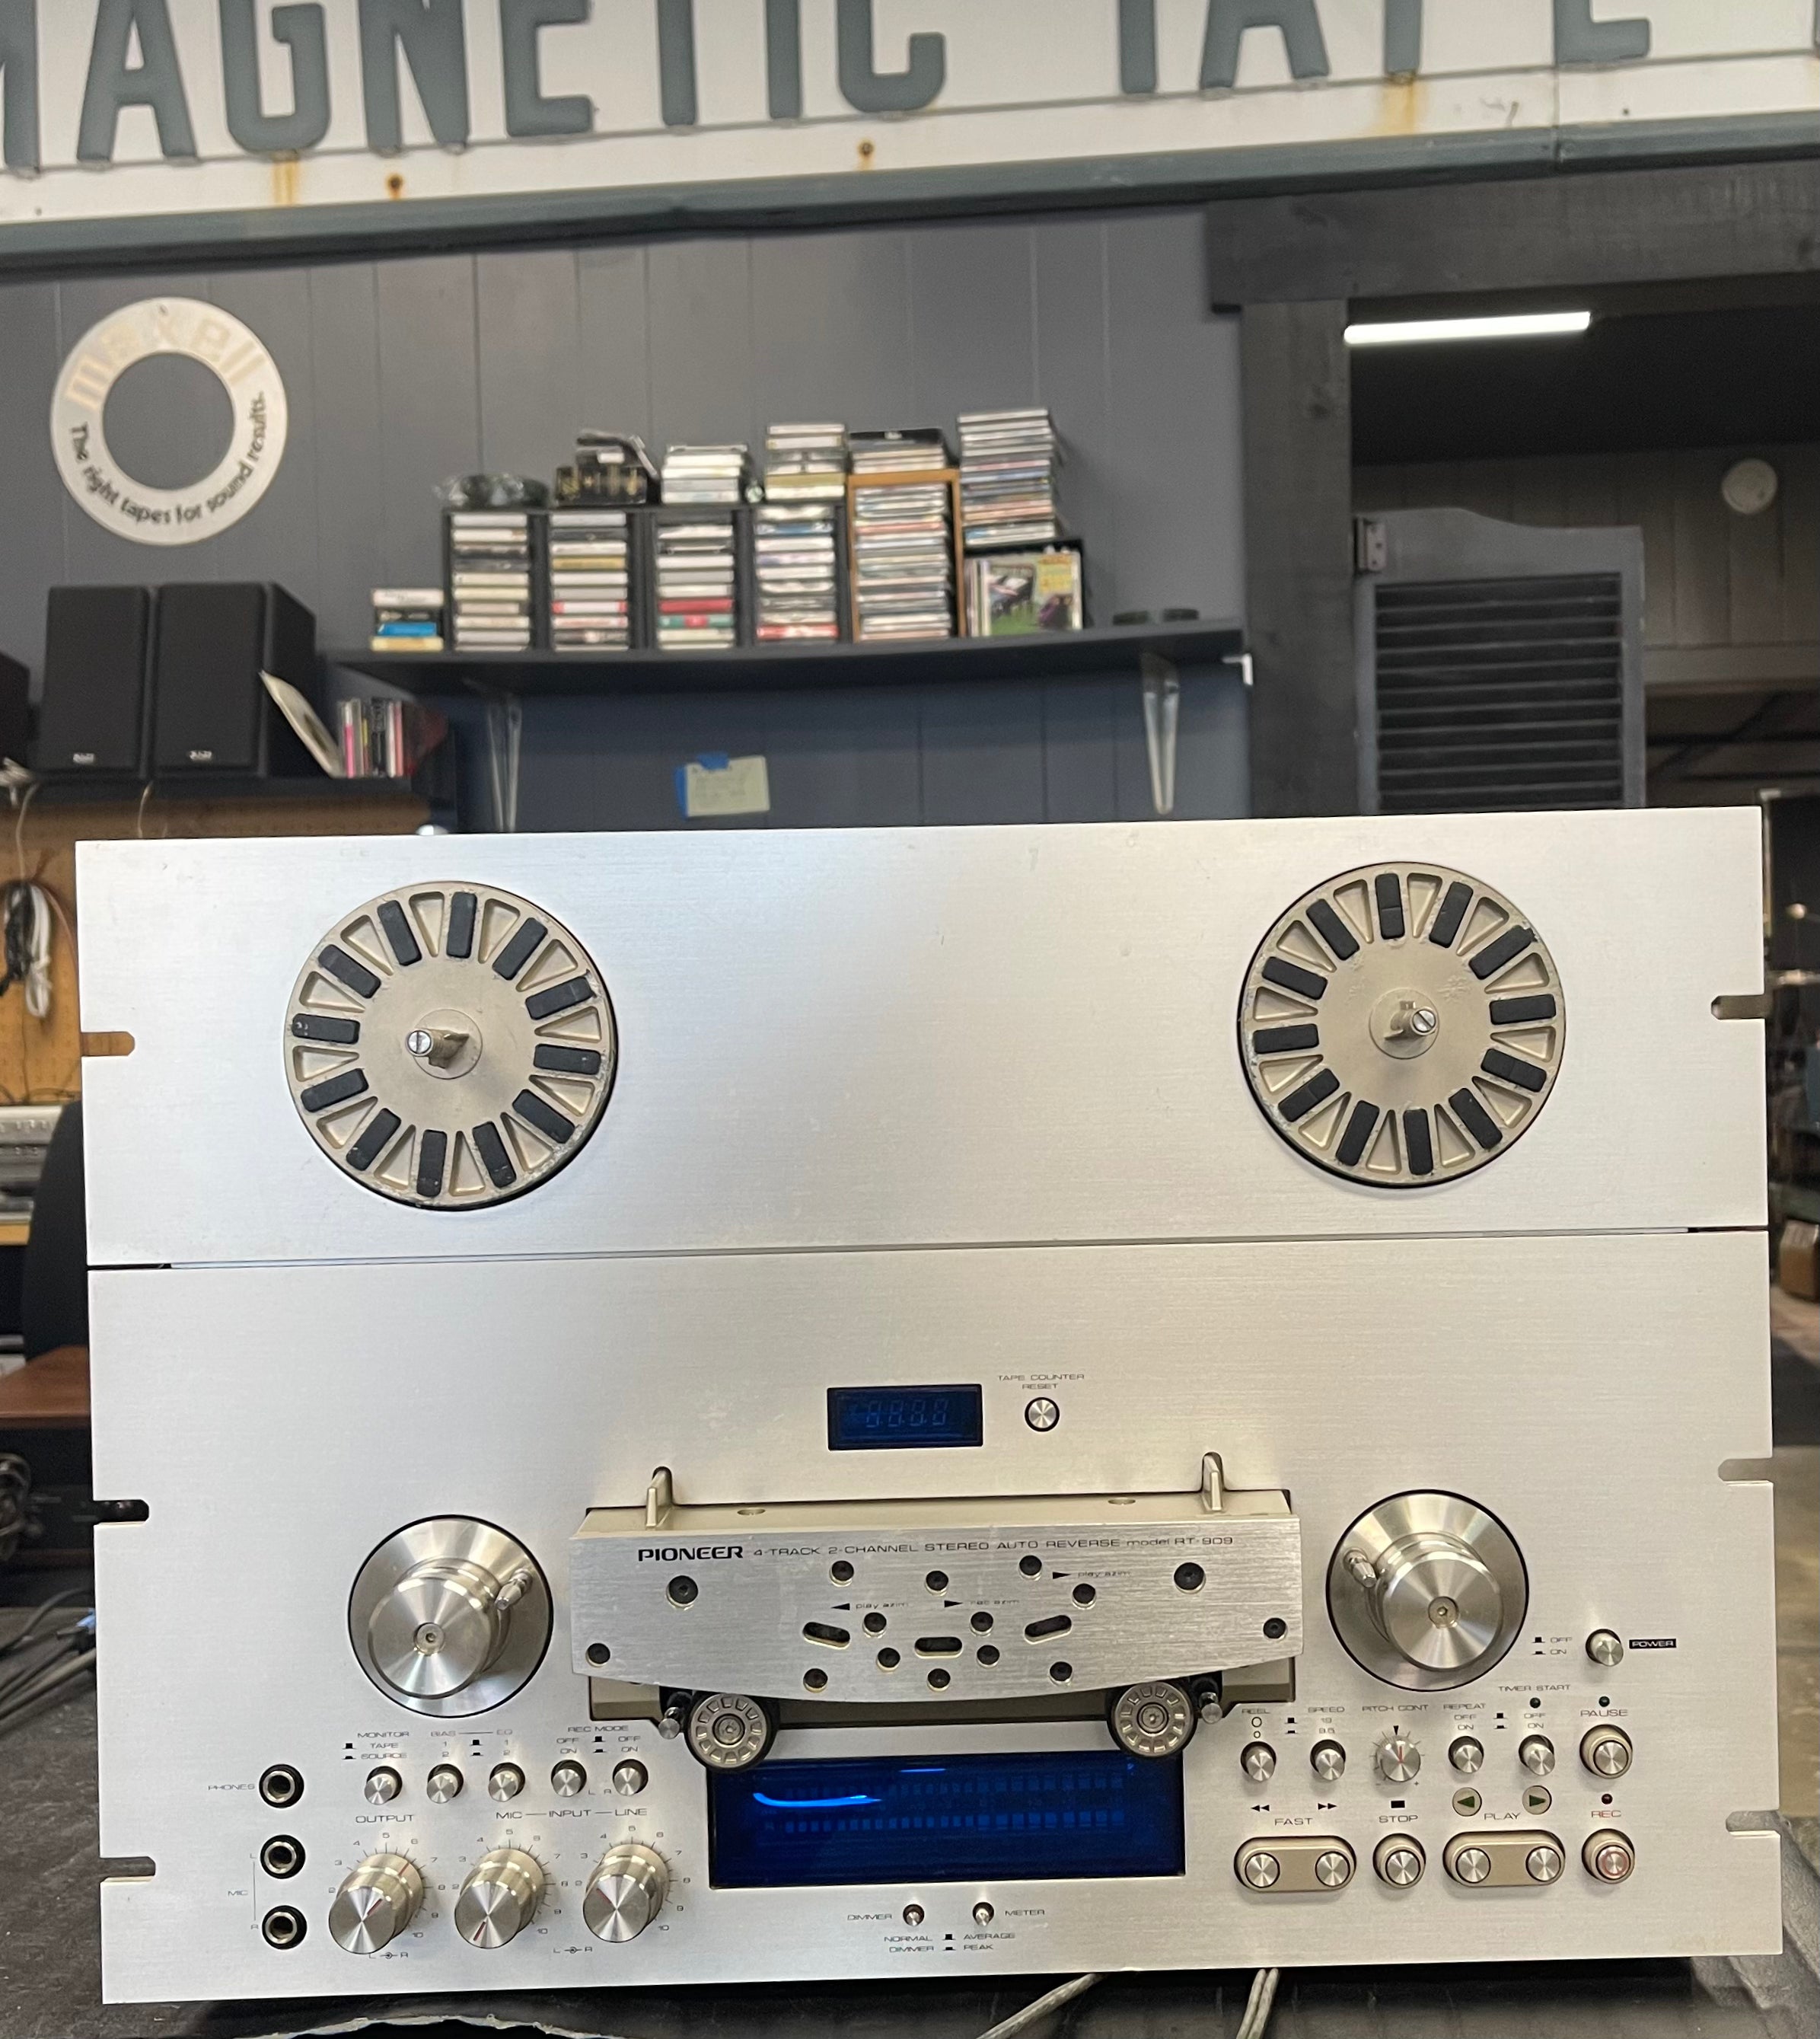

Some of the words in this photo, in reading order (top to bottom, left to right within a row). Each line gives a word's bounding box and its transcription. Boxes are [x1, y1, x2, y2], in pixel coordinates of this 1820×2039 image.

[71, 422, 88, 462] The
[84, 464, 120, 505] right
[121, 499, 171, 525] tapes
[176, 505, 202, 525] for
[206, 459, 254, 512] sound
[638, 1546, 744, 1562] PIONEER
[754, 1547, 820, 1556] 4-TRACK
[828, 1544, 918, 1556] 2-CHANNEL
[924, 1541, 990, 1552] STEREO
[997, 1540, 1038, 1549] AUTO
[1046, 1539, 1120, 1549] REVERSE
[1175, 1536, 1233, 1546] RT-909
[855, 1602, 879, 1610] play
[1580, 1709, 1628, 1718] PAUSE
[496, 1811, 523, 1820] MIC
[549, 1809, 591, 1817] INPUT
[615, 1808, 647, 1817] LINE
[1379, 1814, 1418, 1823] STOP
[1484, 1812, 1521, 1820] PLAY
[1591, 1810, 1622, 1818] REC
[355, 1814, 414, 1824] OUTPUT
[1274, 1817, 1313, 1826] FAST
